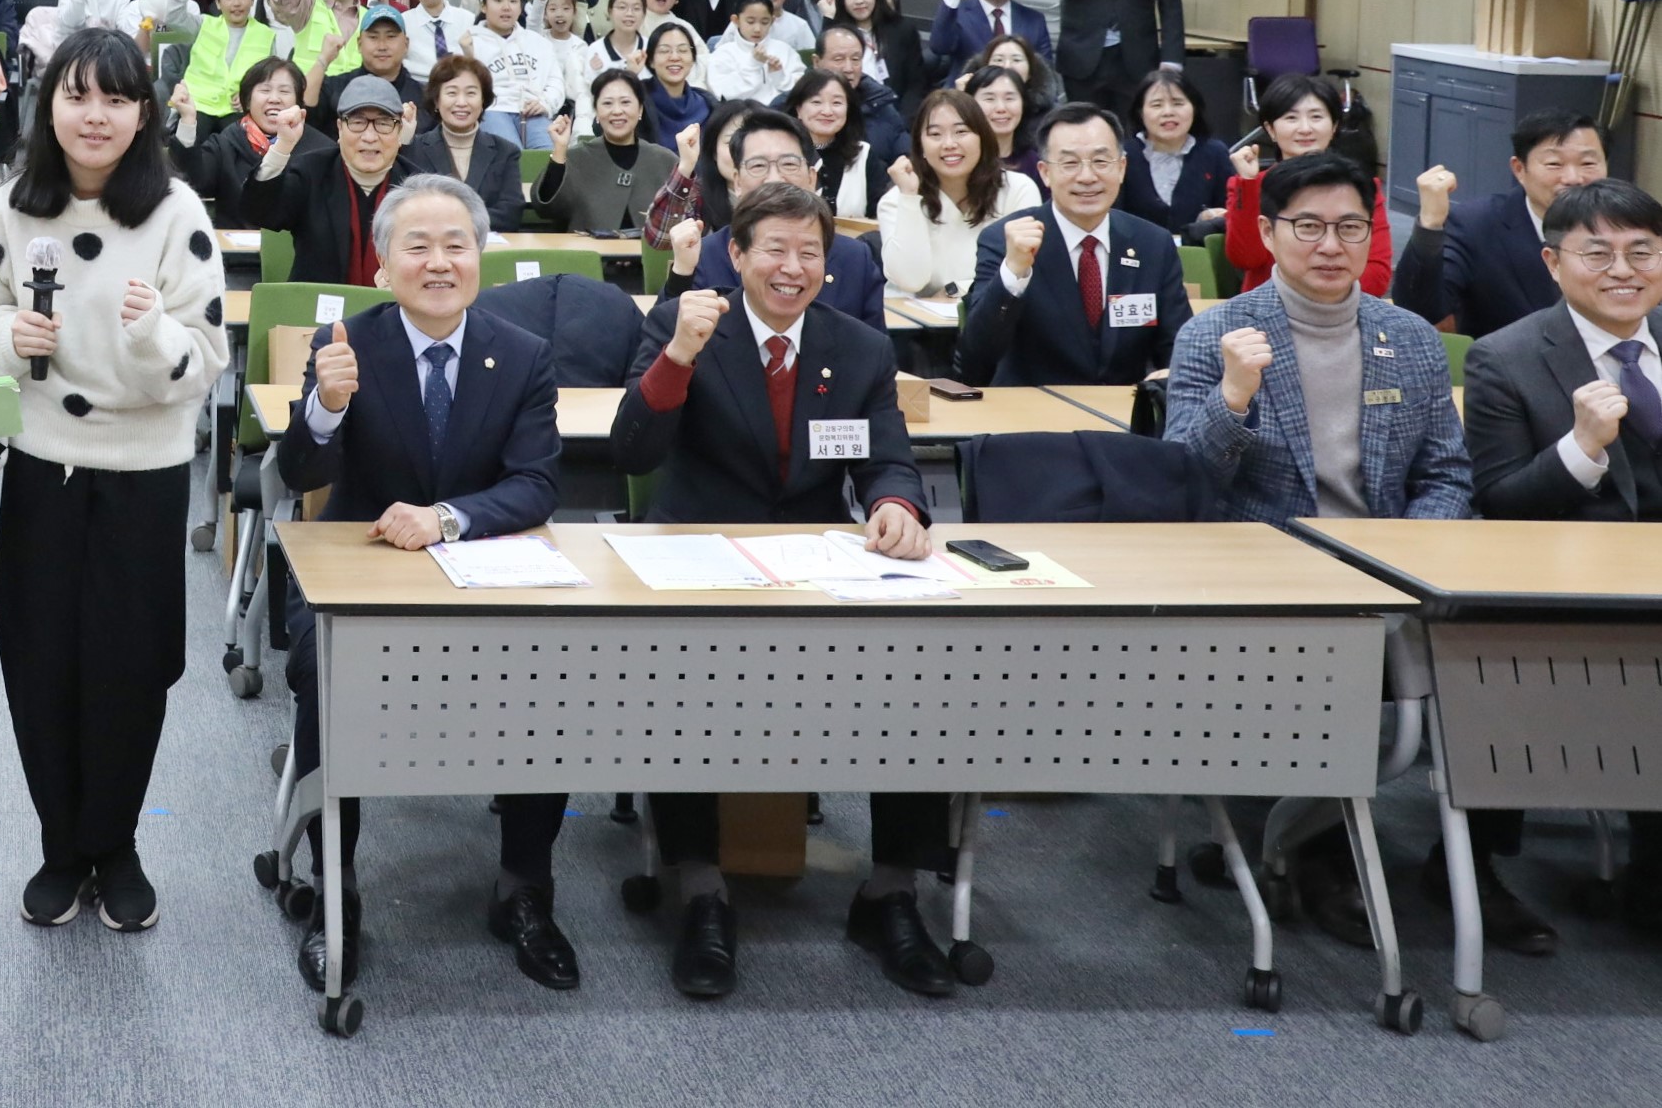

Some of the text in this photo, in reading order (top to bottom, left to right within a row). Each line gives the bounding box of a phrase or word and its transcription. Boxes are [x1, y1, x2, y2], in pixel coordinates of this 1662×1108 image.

[488, 53, 538, 74] COLEE
[1113, 303, 1153, 317] 남효선
[817, 444, 862, 456] 서회원
